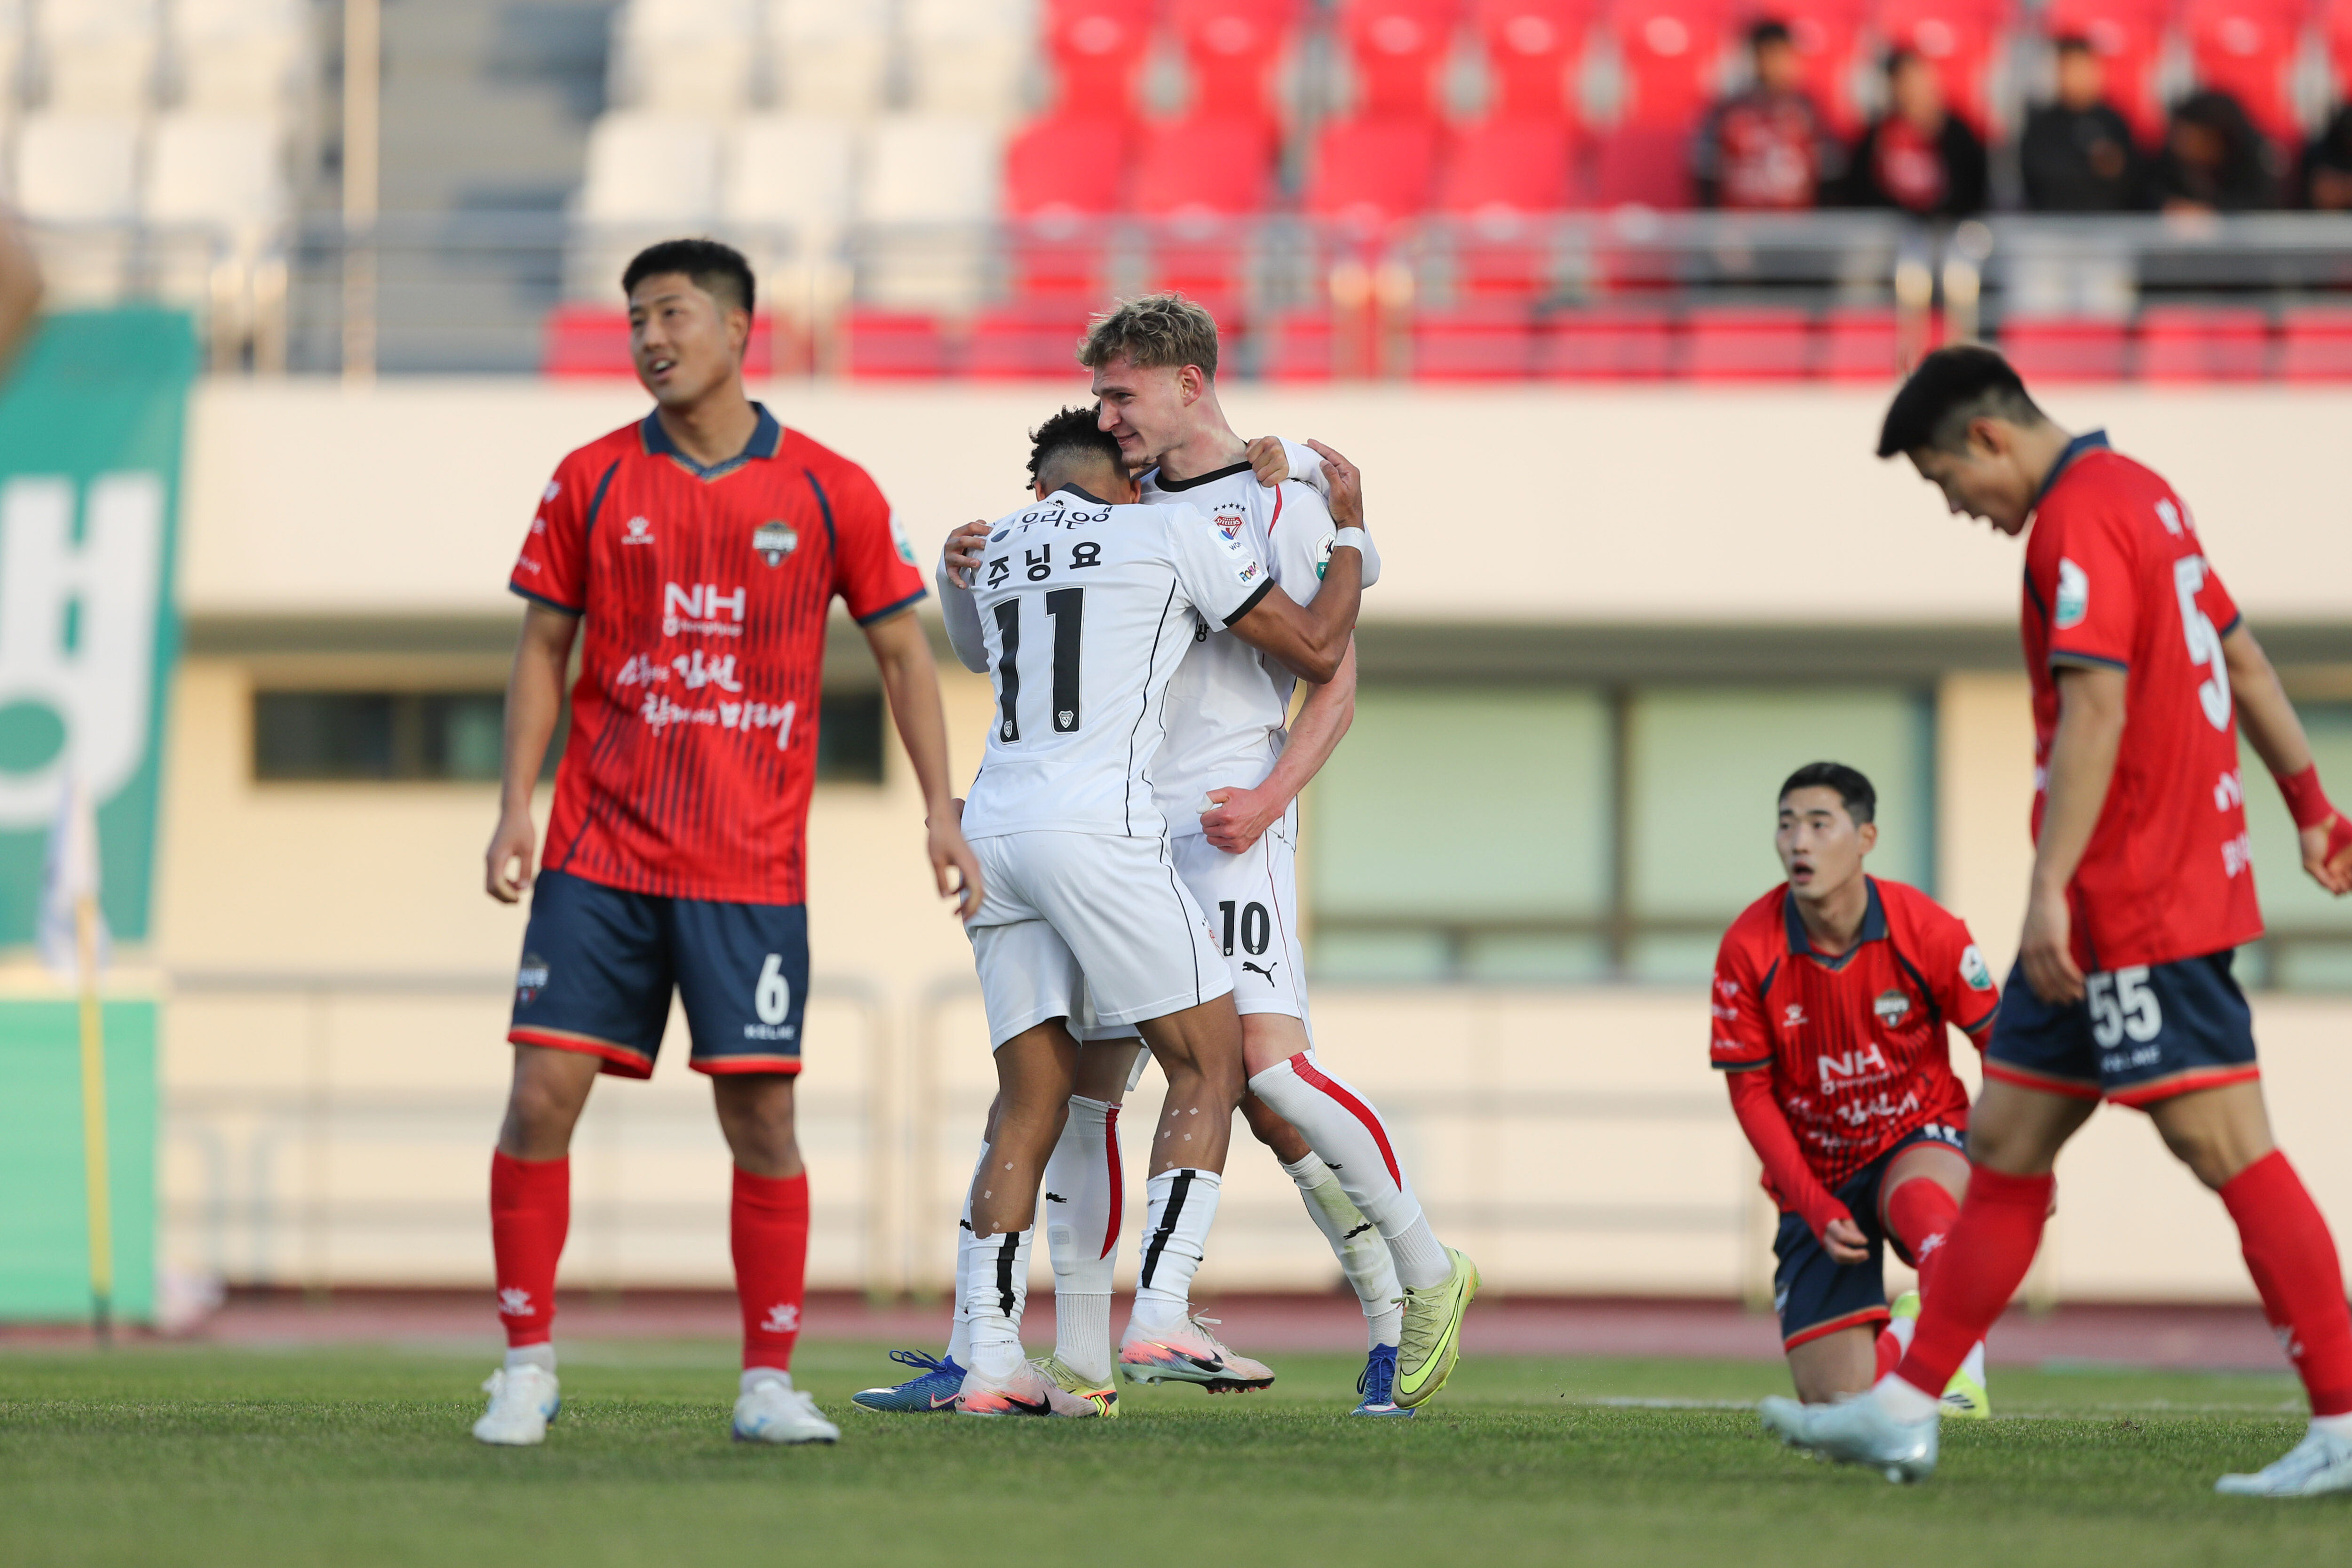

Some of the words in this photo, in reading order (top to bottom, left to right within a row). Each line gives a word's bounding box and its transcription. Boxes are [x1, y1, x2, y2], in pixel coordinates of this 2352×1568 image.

[987, 542, 1101, 589] 주닝요
[665, 582, 746, 622] NH
[992, 586, 1086, 744] 11
[2174, 555, 2232, 732] 5
[1219, 900, 1270, 957] 10
[755, 953, 790, 1025] 6
[2087, 965, 2162, 1049] 55
[1818, 1042, 1886, 1082] NH
